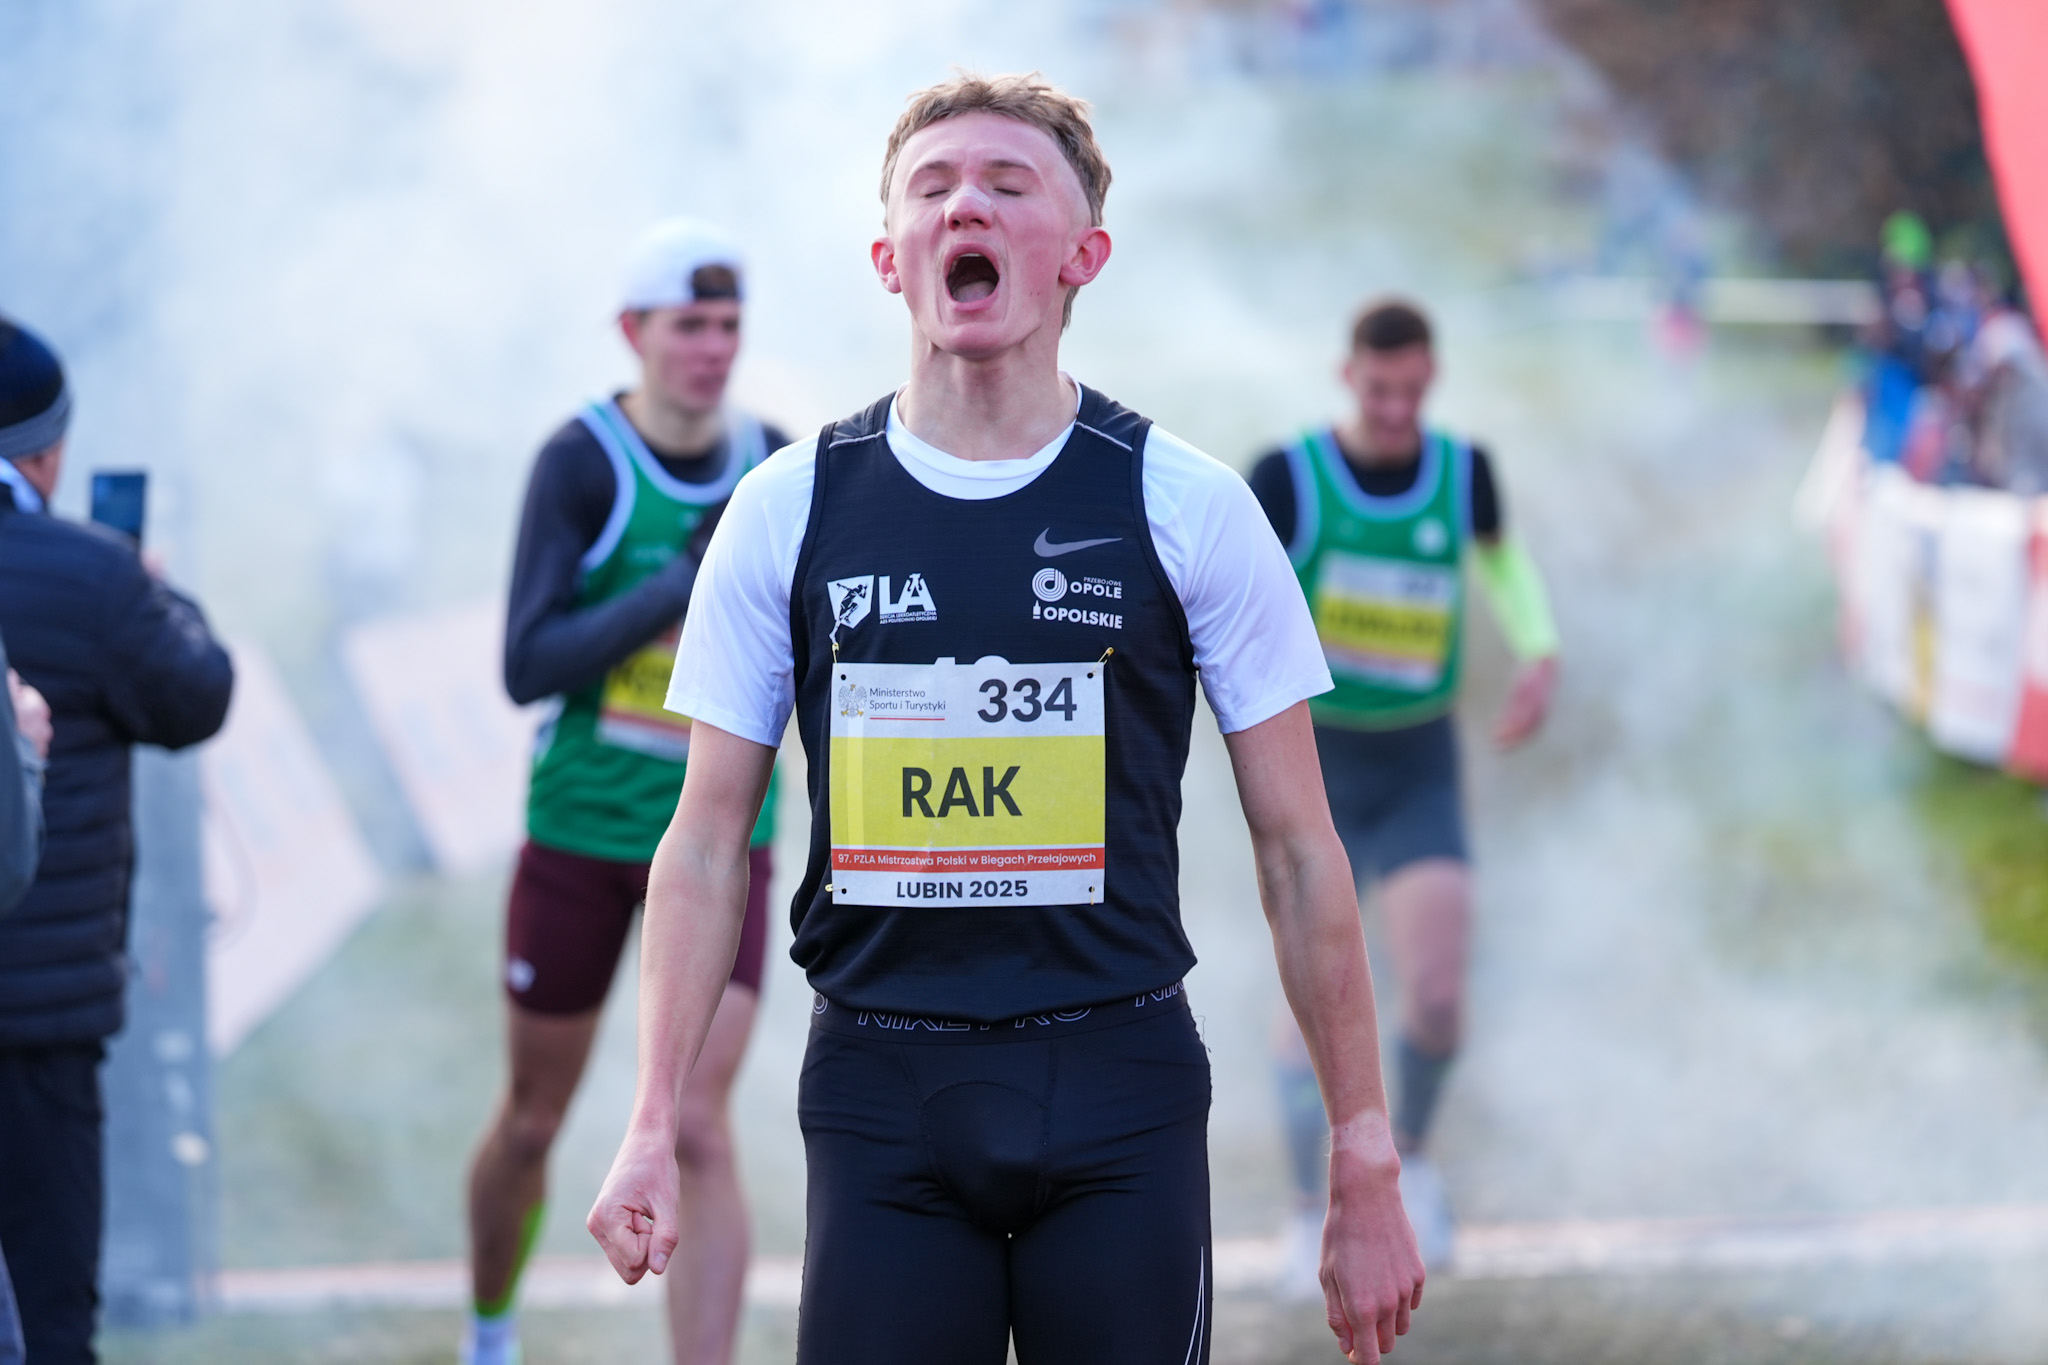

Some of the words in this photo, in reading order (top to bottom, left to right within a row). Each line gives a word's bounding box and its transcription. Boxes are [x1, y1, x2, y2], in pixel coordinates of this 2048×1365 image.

[1070, 581, 1122, 599] OPOLE
[1083, 576, 1122, 587] PRZEBOJOWE
[879, 573, 936, 614] LA
[1043, 606, 1122, 629] OPOLSKIE
[869, 687, 925, 698] Ministerstwo
[977, 677, 1077, 723] 334
[869, 700, 898, 711] Sportu
[900, 700, 903, 710] i
[906, 700, 946, 712] Turystyki
[902, 766, 1023, 818] RAK
[838, 853, 852, 864] 97.
[854, 854, 876, 864] PZLA
[878, 854, 934, 866] Mistrzostwa
[936, 855, 967, 866] Polski
[969, 857, 979, 865] w
[981, 855, 1025, 867] Biegach
[897, 881, 963, 899] LUBIN
[969, 880, 1028, 898] 2025
